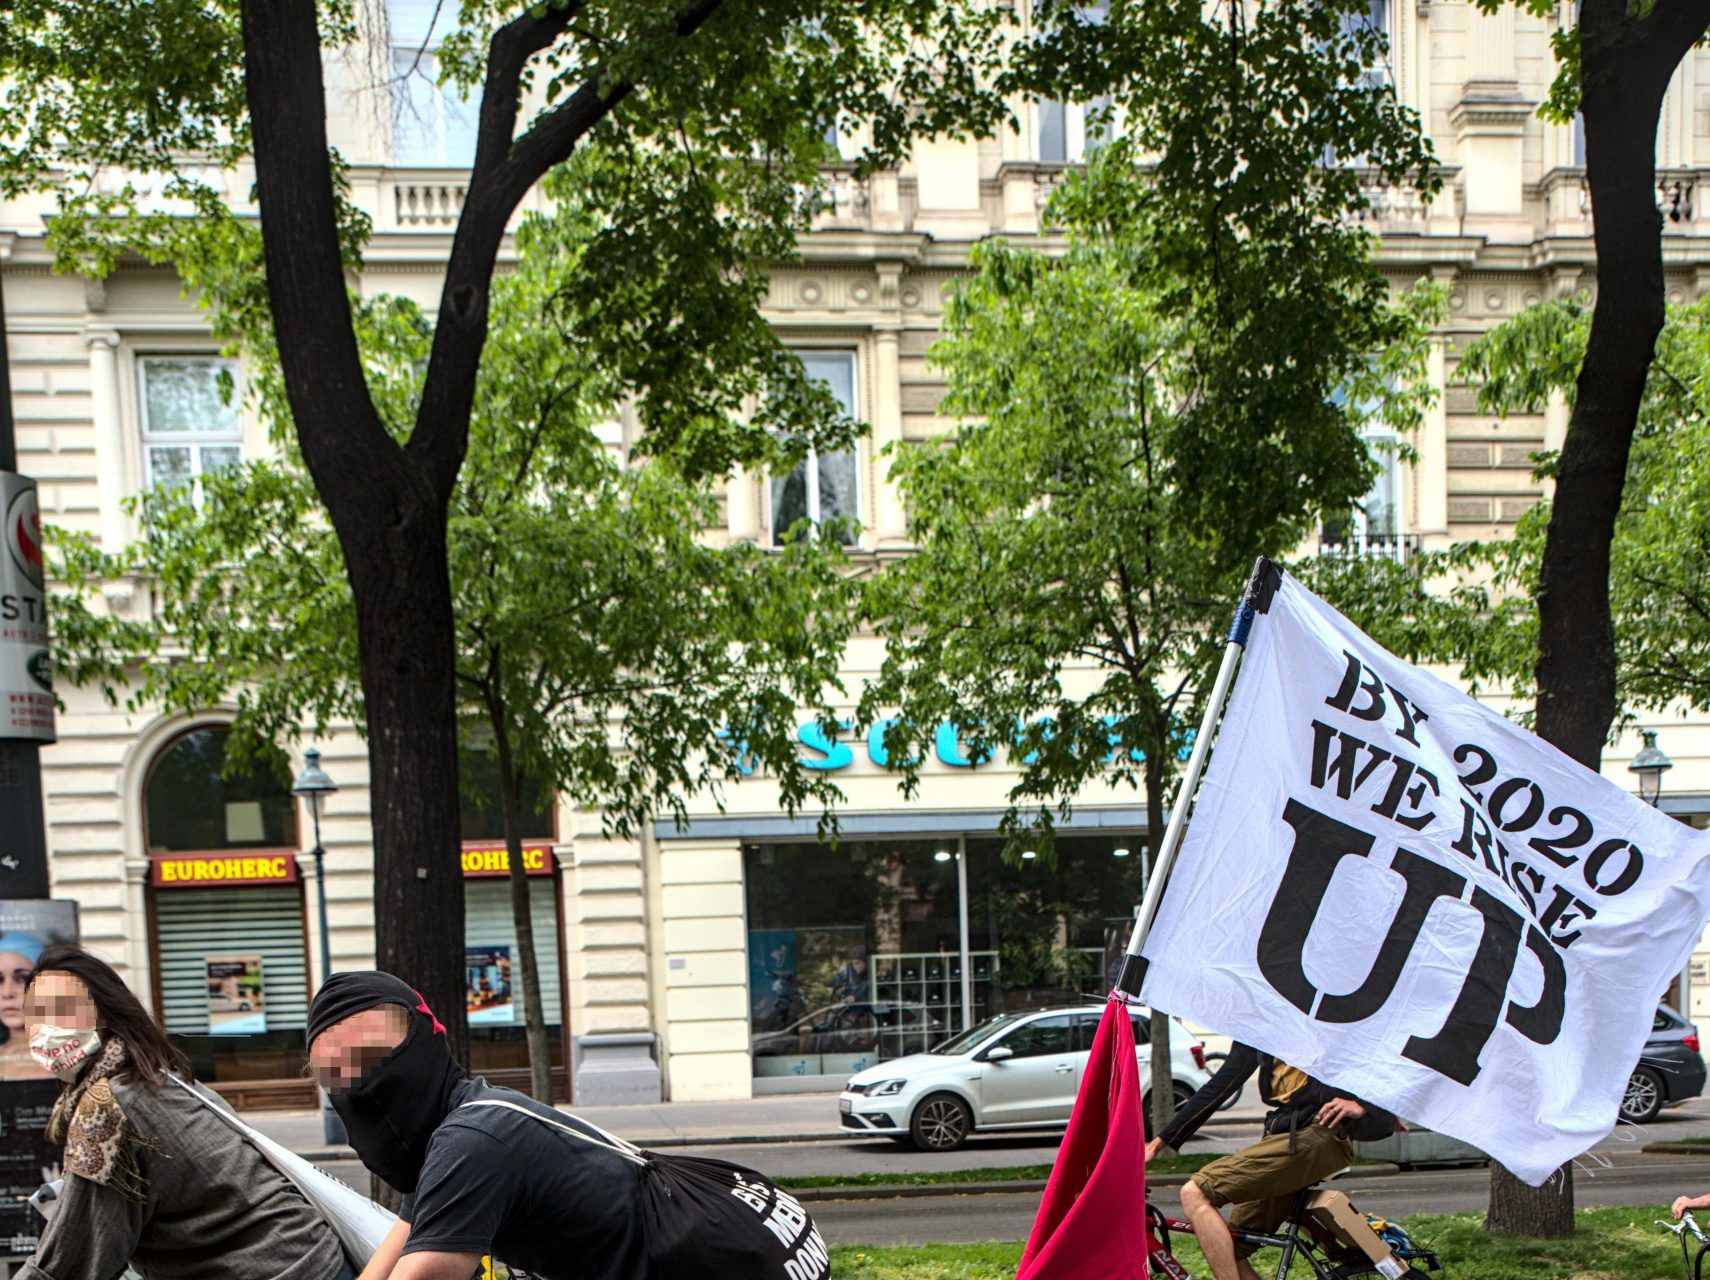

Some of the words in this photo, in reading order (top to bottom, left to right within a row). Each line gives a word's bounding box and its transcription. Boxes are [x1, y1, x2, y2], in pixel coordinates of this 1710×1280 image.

[160, 857, 287, 881] EUROHERC
[1310, 719, 1439, 831] WE
[1451, 799, 1597, 949] RISE
[1325, 649, 1429, 748] BY
[1454, 743, 1644, 896] 2020
[1257, 797, 1567, 1086] UP
